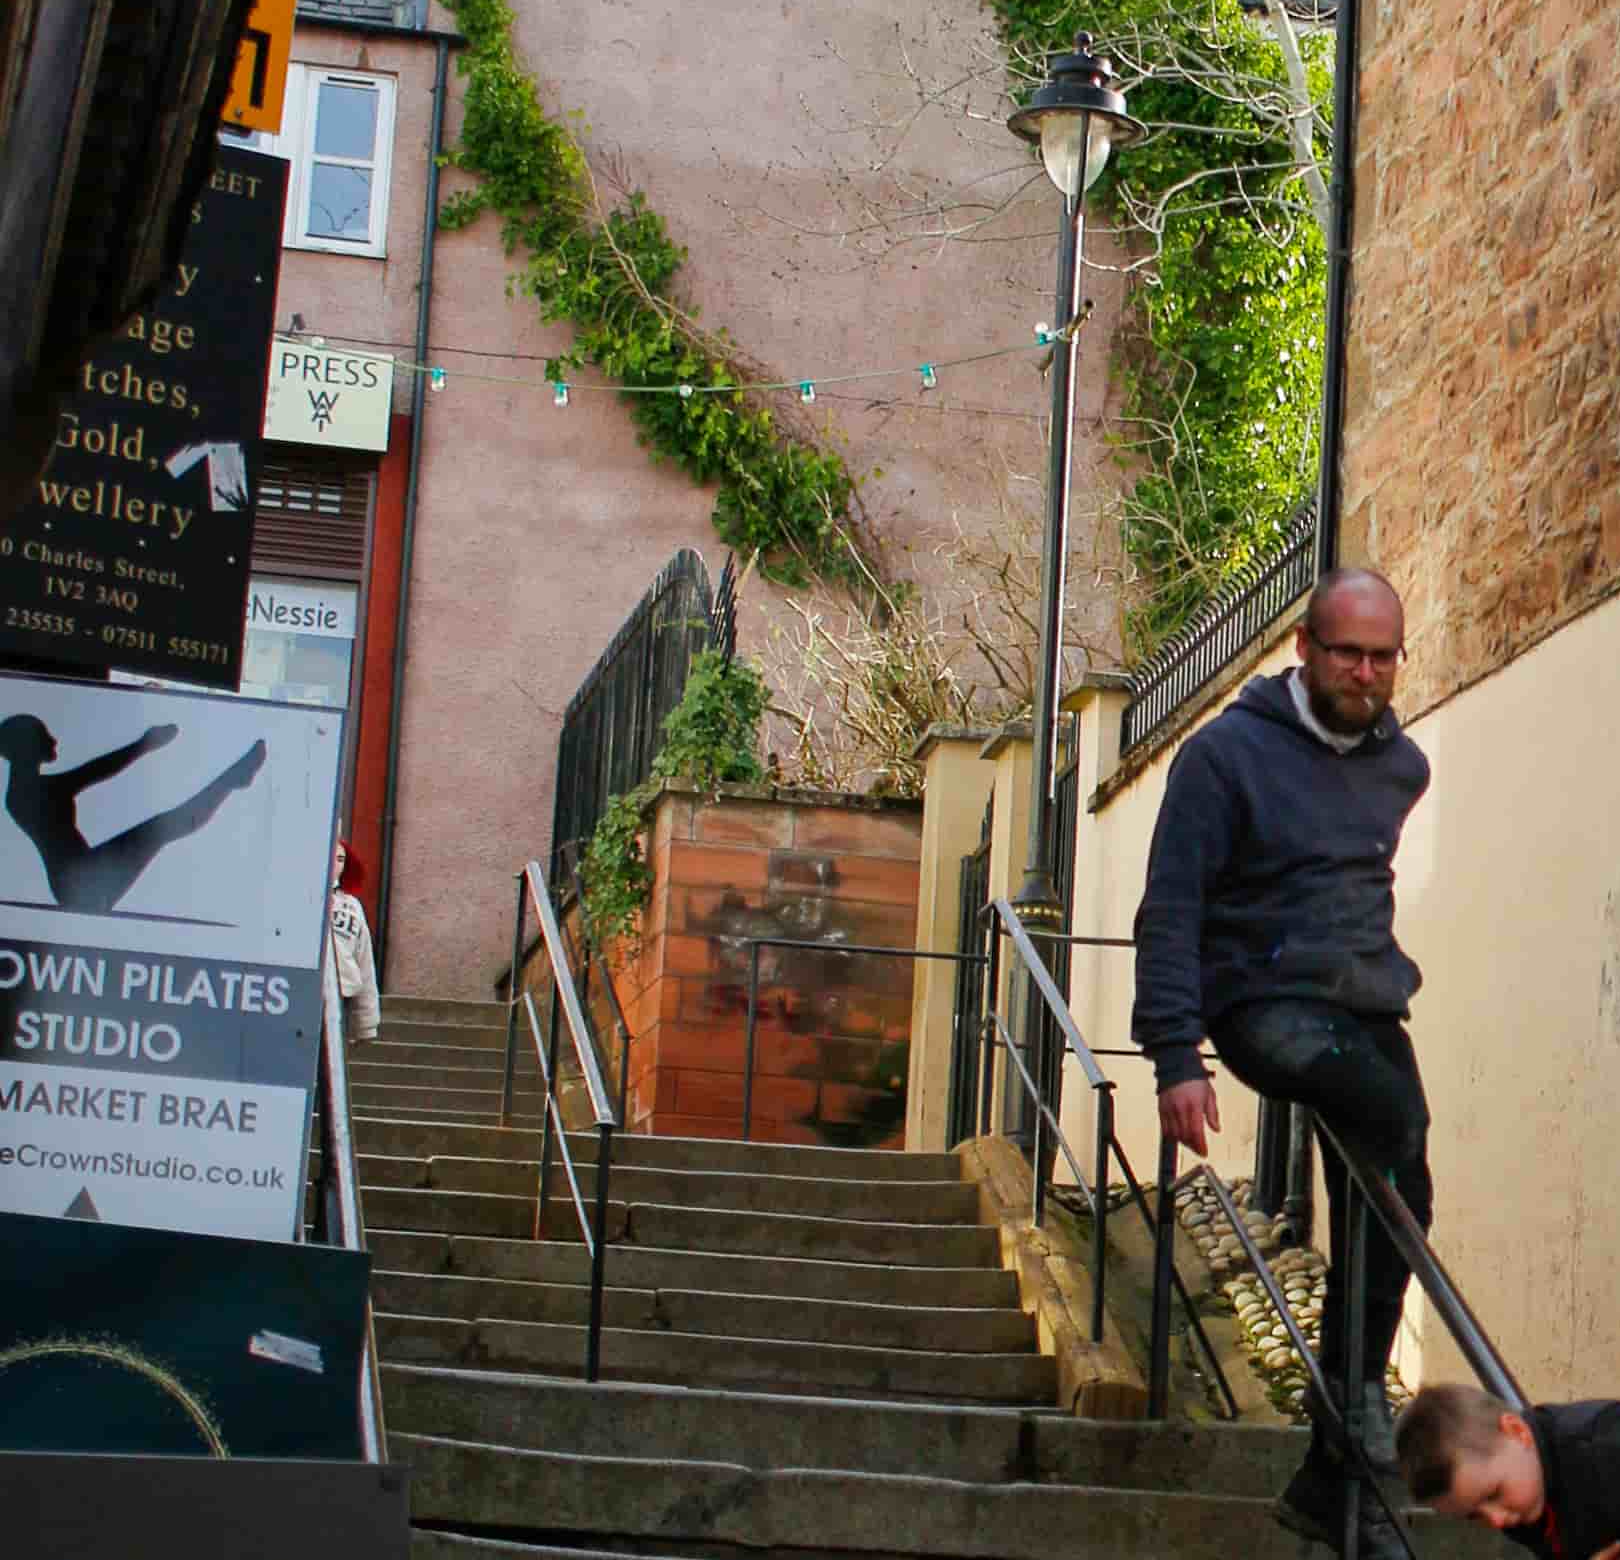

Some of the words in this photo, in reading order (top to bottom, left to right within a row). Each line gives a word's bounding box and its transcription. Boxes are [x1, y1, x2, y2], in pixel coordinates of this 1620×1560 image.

[280, 352, 378, 389] PRESS
[24, 541, 105, 574] Charles
[120, 961, 291, 1017] PILATES
[14, 1010, 182, 1063] STUDIO
[158, 1092, 258, 1134] BRAE
